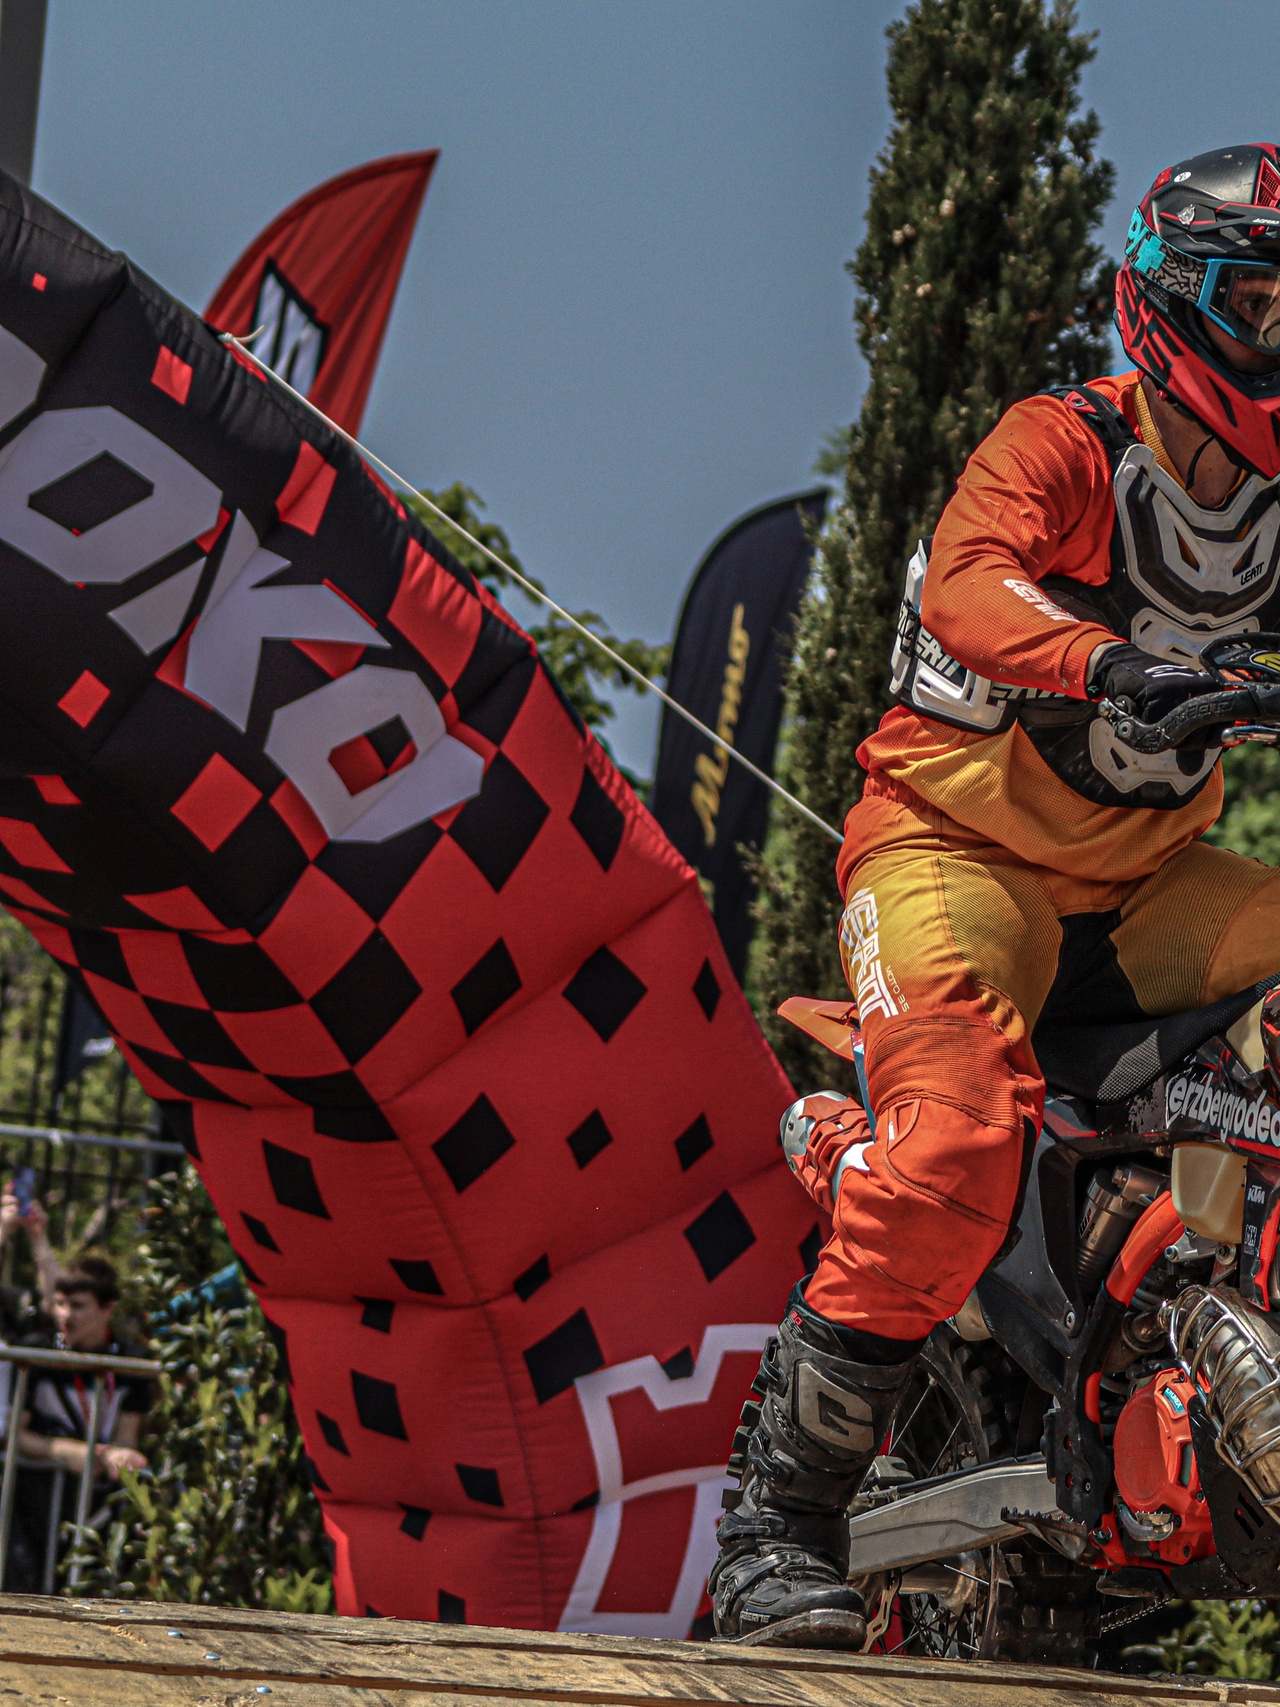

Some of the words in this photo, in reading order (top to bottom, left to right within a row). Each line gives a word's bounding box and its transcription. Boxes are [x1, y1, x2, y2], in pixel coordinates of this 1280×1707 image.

[1240, 562, 1265, 585] LEATT
[885, 964, 901, 994] MOTO
[1247, 1184, 1266, 1205] KTM
